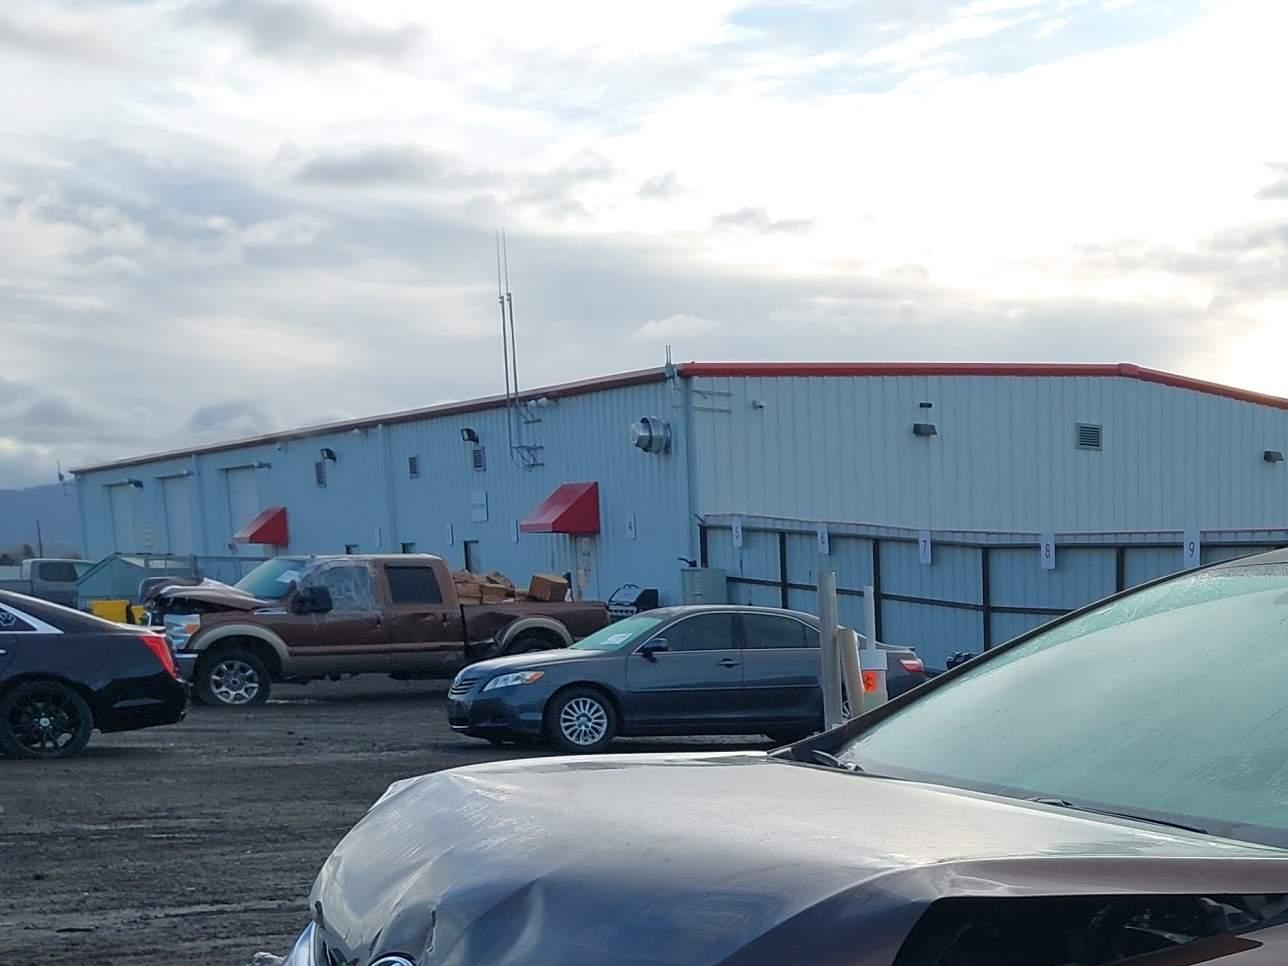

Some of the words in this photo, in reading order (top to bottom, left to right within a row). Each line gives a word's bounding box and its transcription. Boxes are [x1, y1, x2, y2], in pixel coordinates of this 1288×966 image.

[921, 539, 928, 553] 7
[1045, 543, 1051, 559] 8
[1188, 541, 1195, 557] 9
